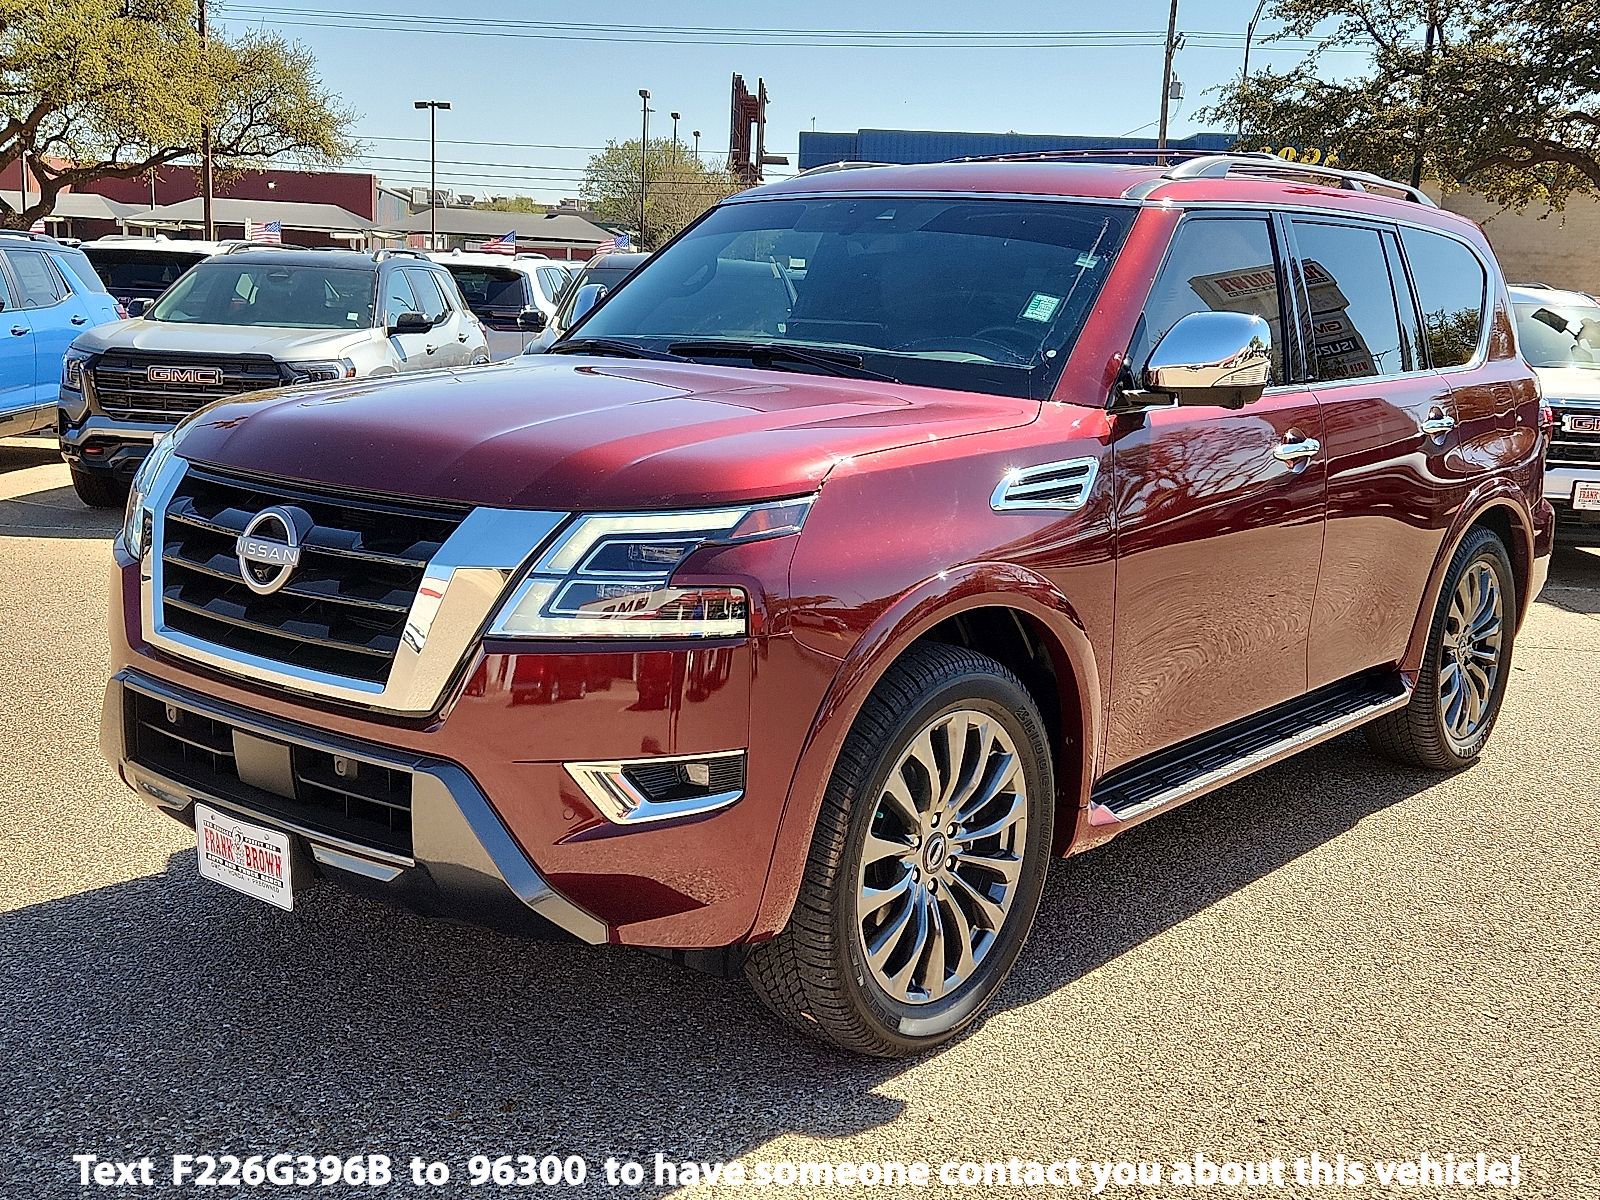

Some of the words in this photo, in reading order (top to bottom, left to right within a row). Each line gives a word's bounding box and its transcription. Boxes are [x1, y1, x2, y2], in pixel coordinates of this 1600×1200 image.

[151, 368, 216, 384] GMC
[239, 540, 297, 562] NISSAN
[204, 827, 234, 861] FRANK
[244, 844, 282, 879] BROWN
[208, 853, 223, 865] AUTO
[238, 866, 258, 878] TRUCK
